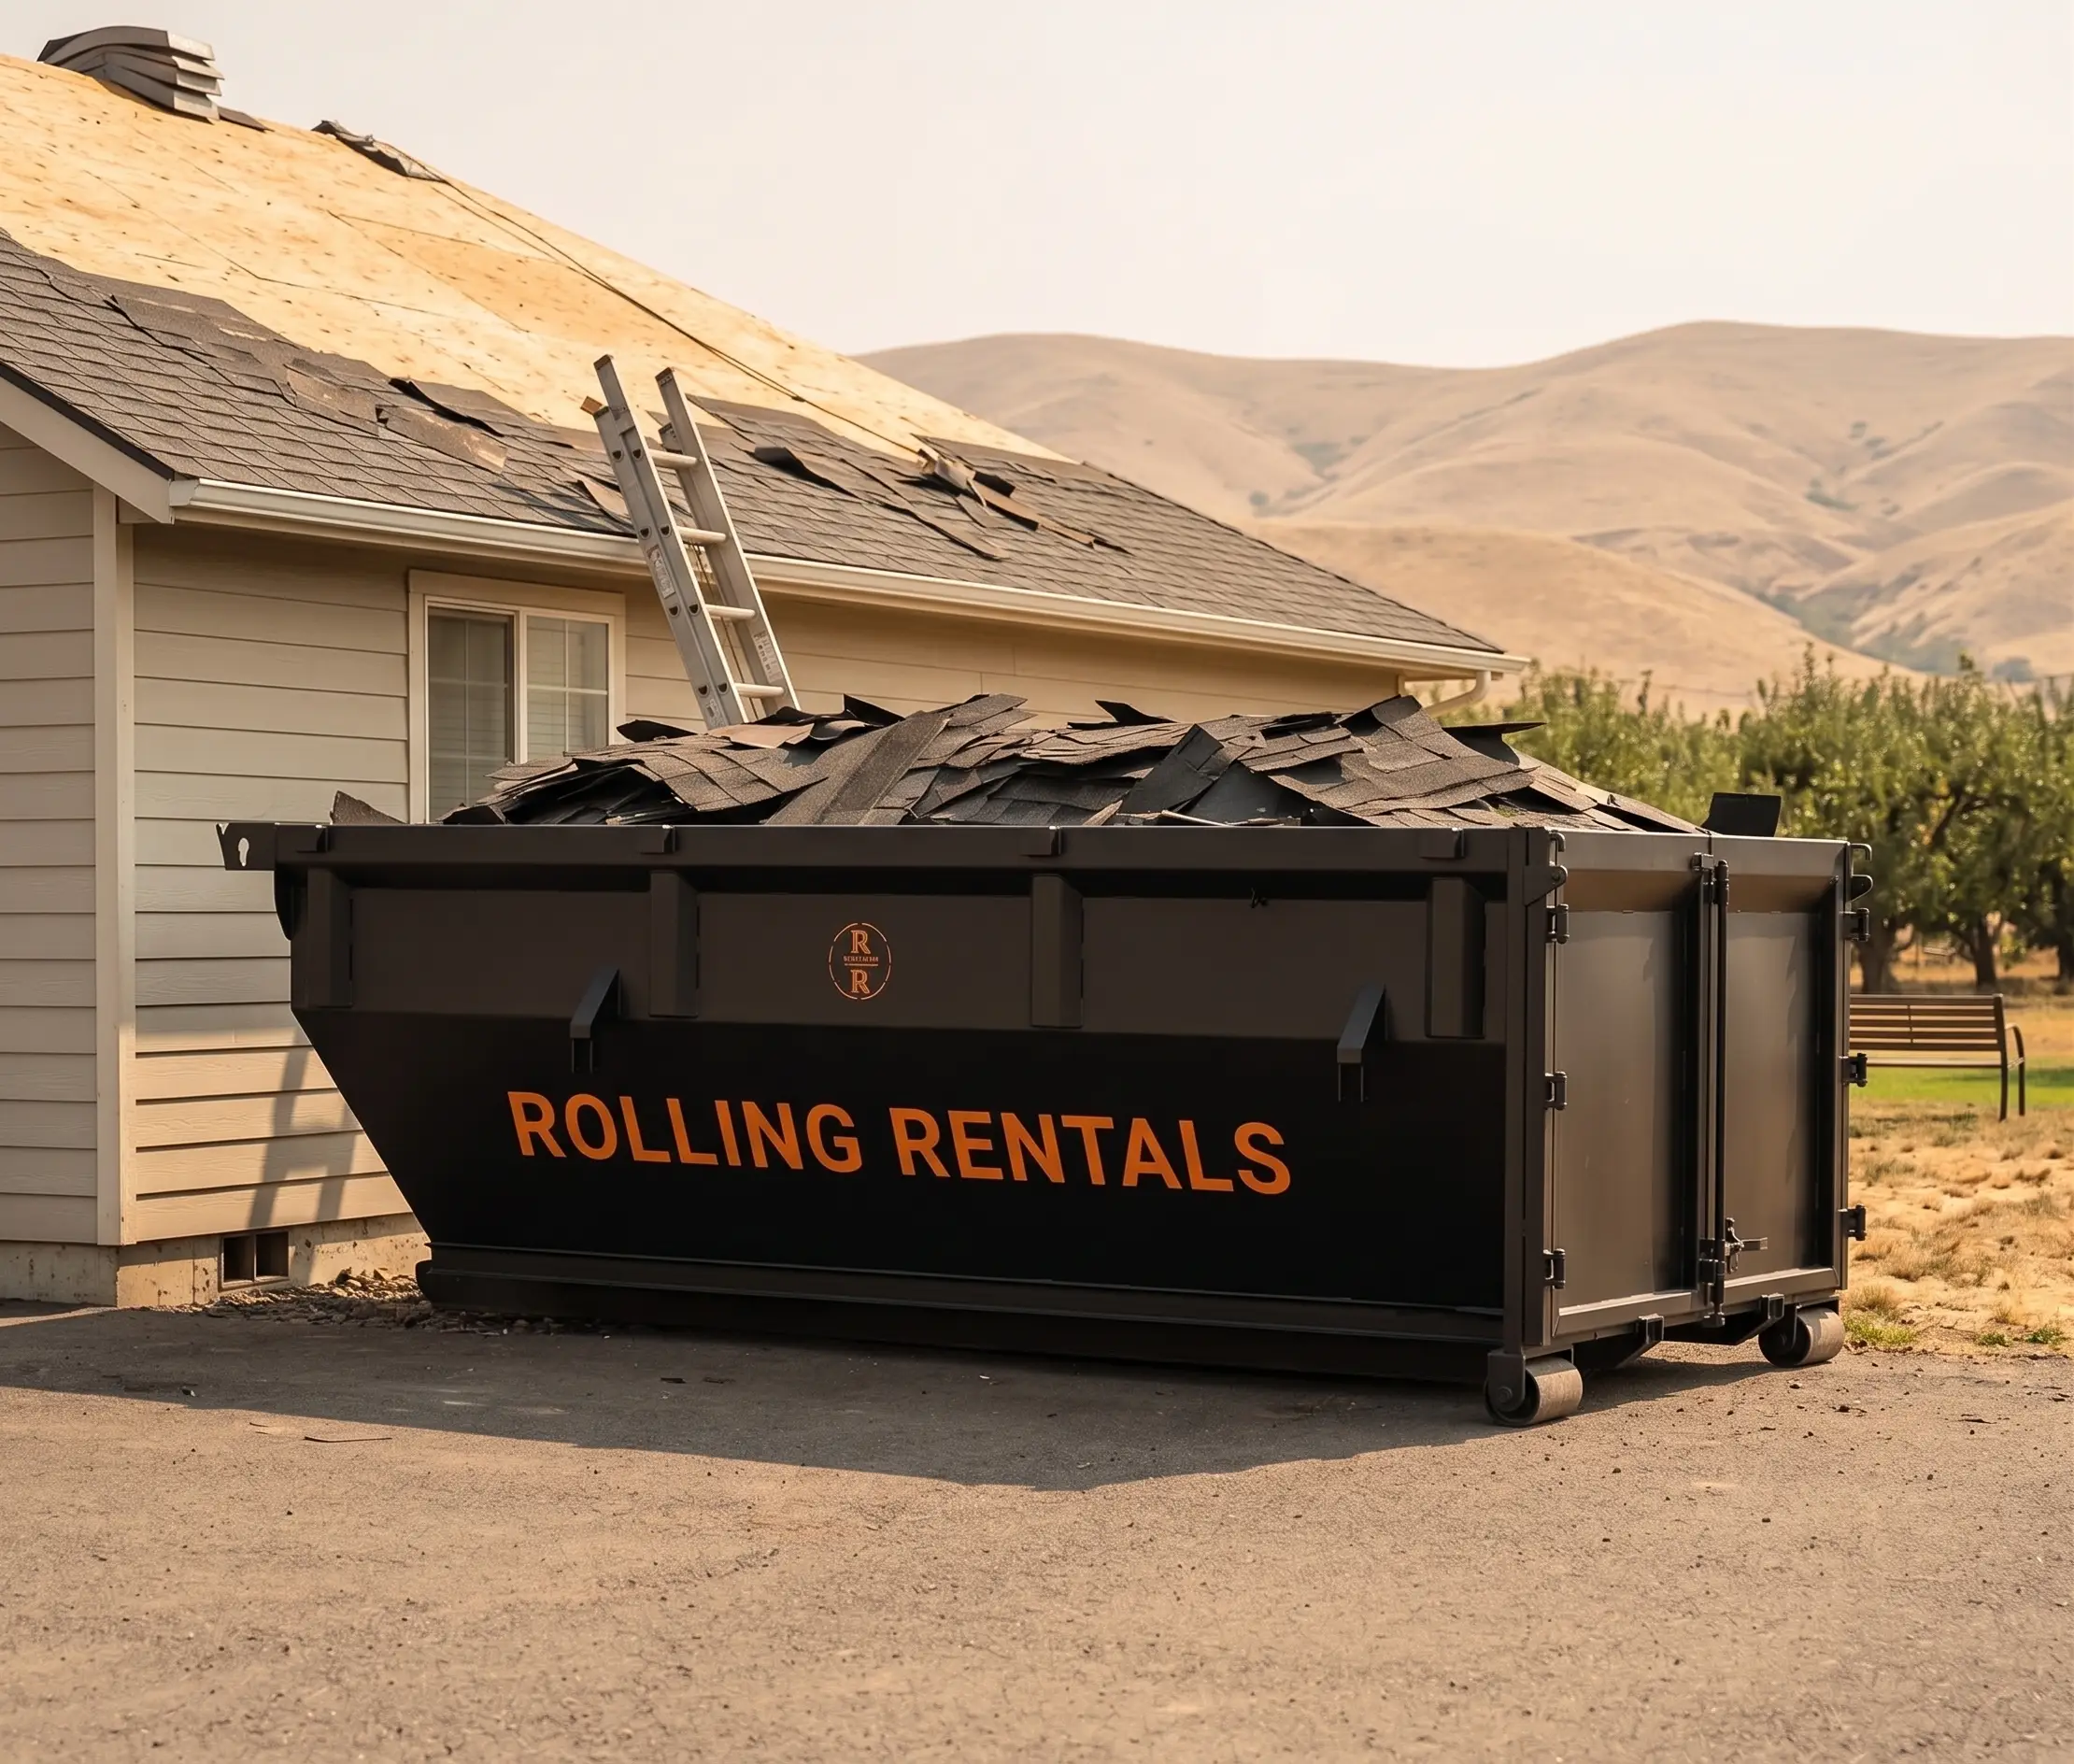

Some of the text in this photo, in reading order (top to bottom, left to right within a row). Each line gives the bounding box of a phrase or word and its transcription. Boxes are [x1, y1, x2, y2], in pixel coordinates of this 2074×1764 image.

[849, 930, 871, 954] R
[849, 969, 871, 994] R
[507, 1090, 1291, 1195] ROLLING RENTALS
